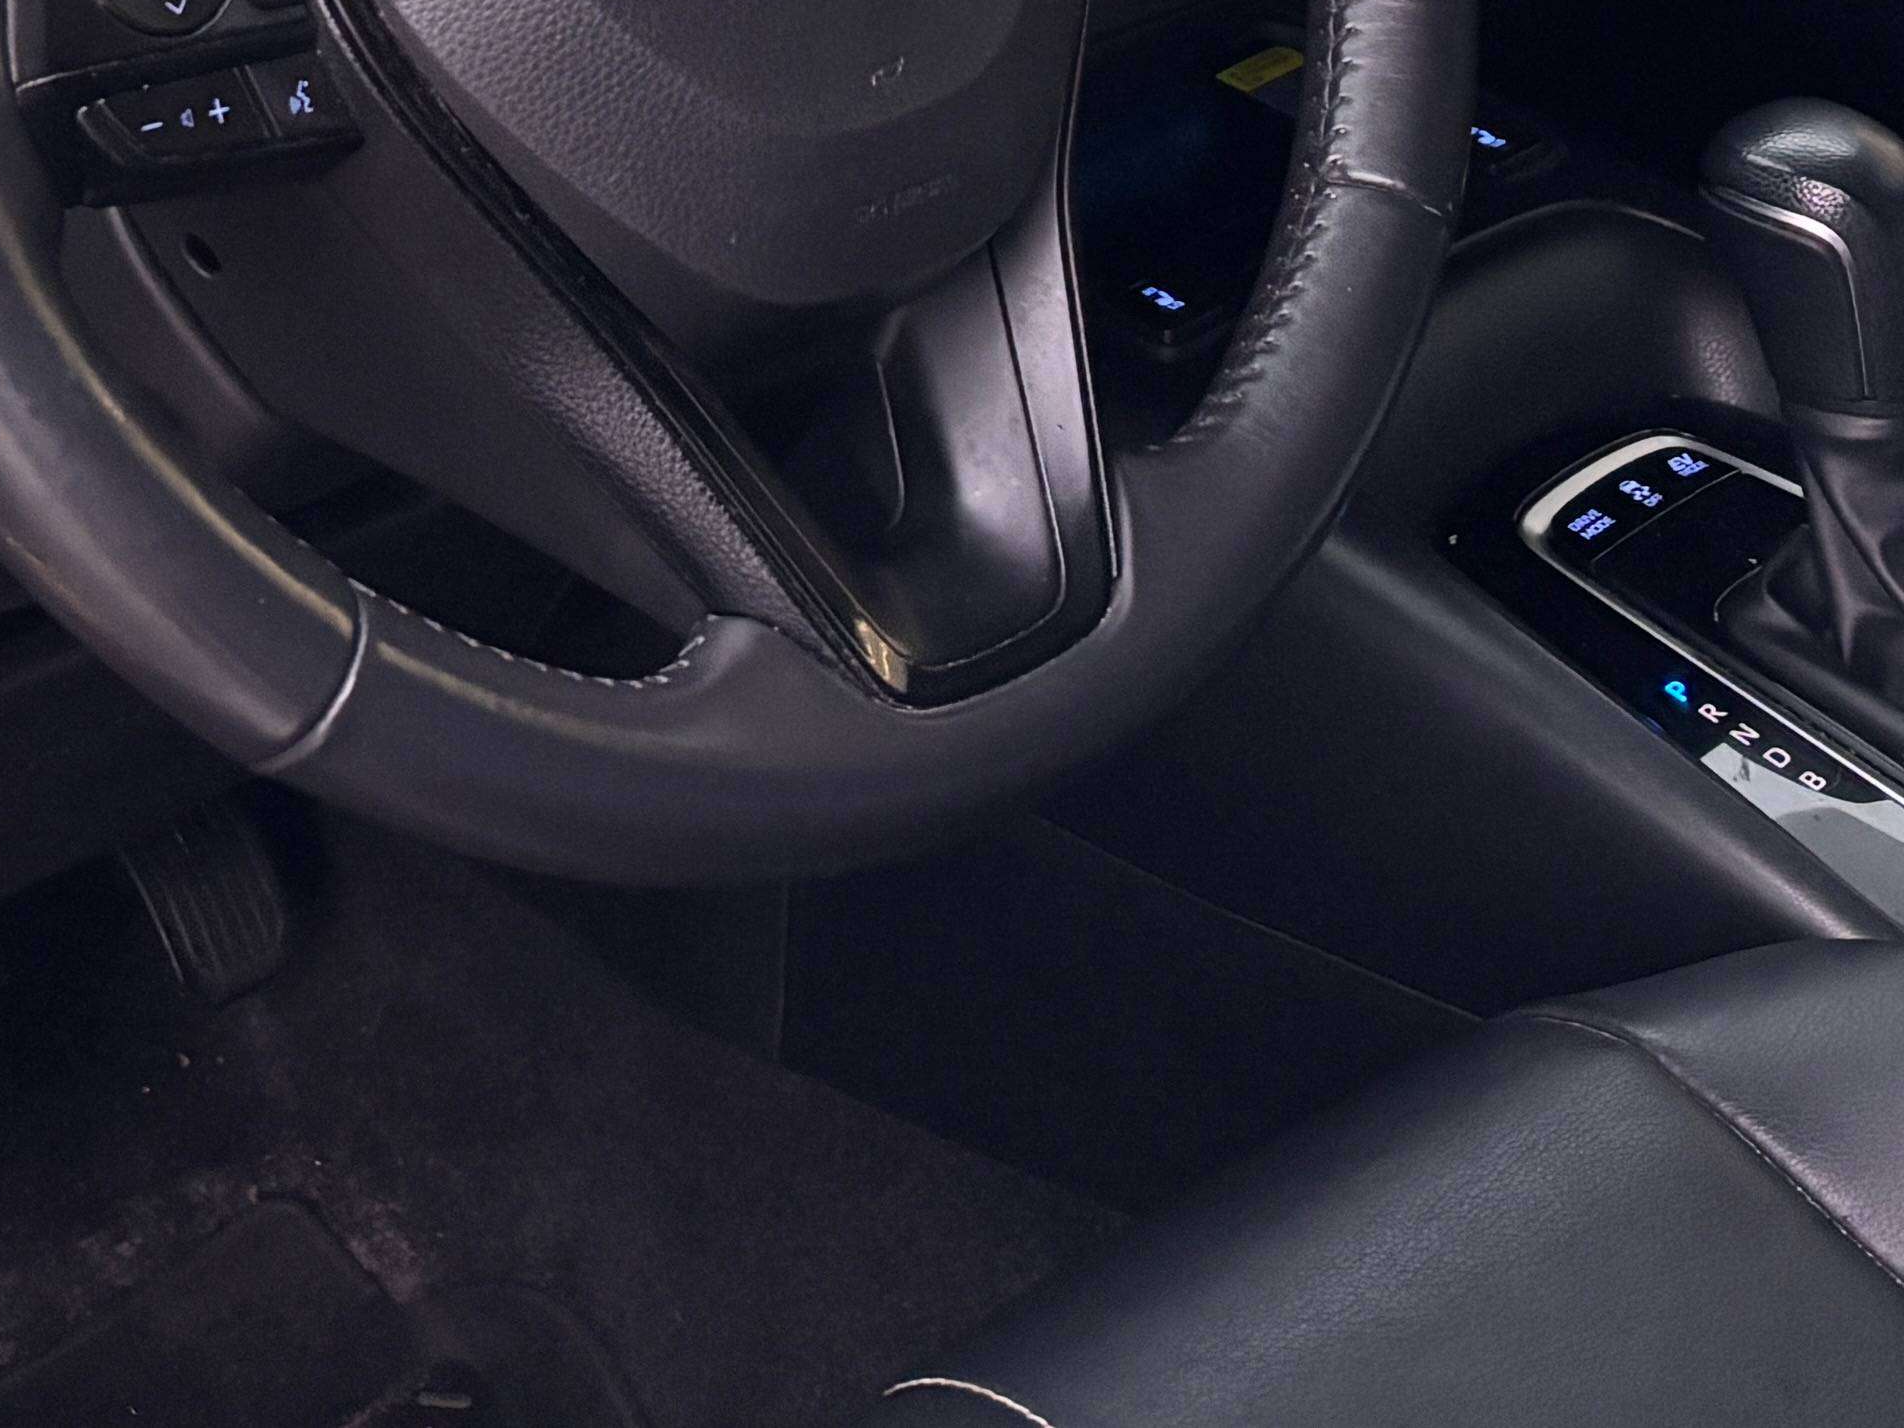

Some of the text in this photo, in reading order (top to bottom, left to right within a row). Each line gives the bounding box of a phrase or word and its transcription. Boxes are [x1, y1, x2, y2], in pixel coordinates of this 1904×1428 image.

[1664, 681, 1688, 702] P
[1698, 703, 1728, 724] R
[1729, 722, 1760, 746] N
[1762, 747, 1791, 769] D
[1798, 770, 1827, 791] B
